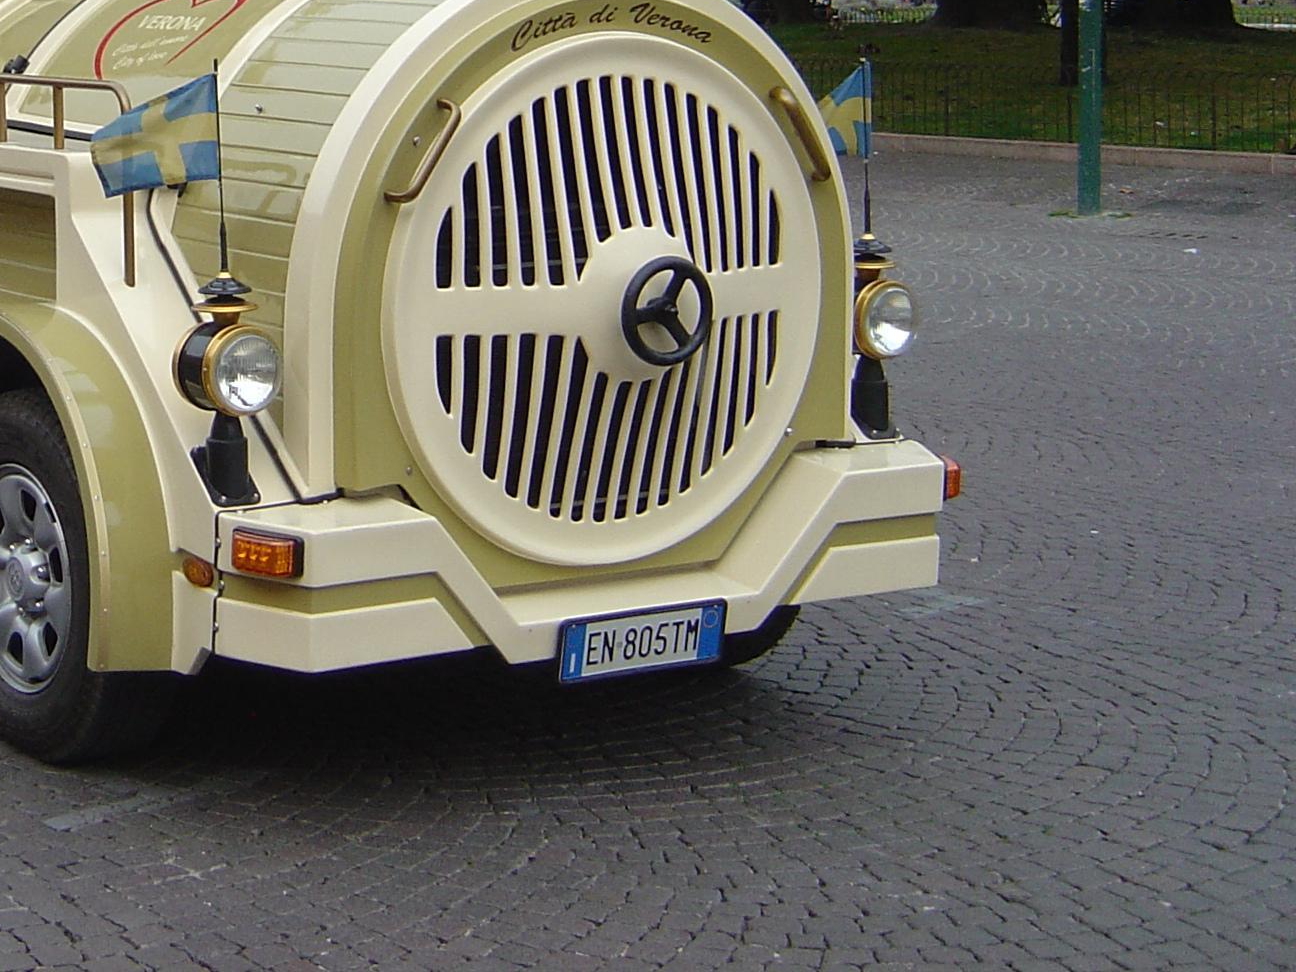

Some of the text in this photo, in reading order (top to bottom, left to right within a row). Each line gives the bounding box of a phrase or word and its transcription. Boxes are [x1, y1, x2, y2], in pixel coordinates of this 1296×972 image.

[138, 15, 206, 31] VERONA
[589, 4, 618, 23] di
[629, 2, 712, 44] Verona
[585, 628, 617, 667] EN
[622, 617, 700, 661] 805TM
